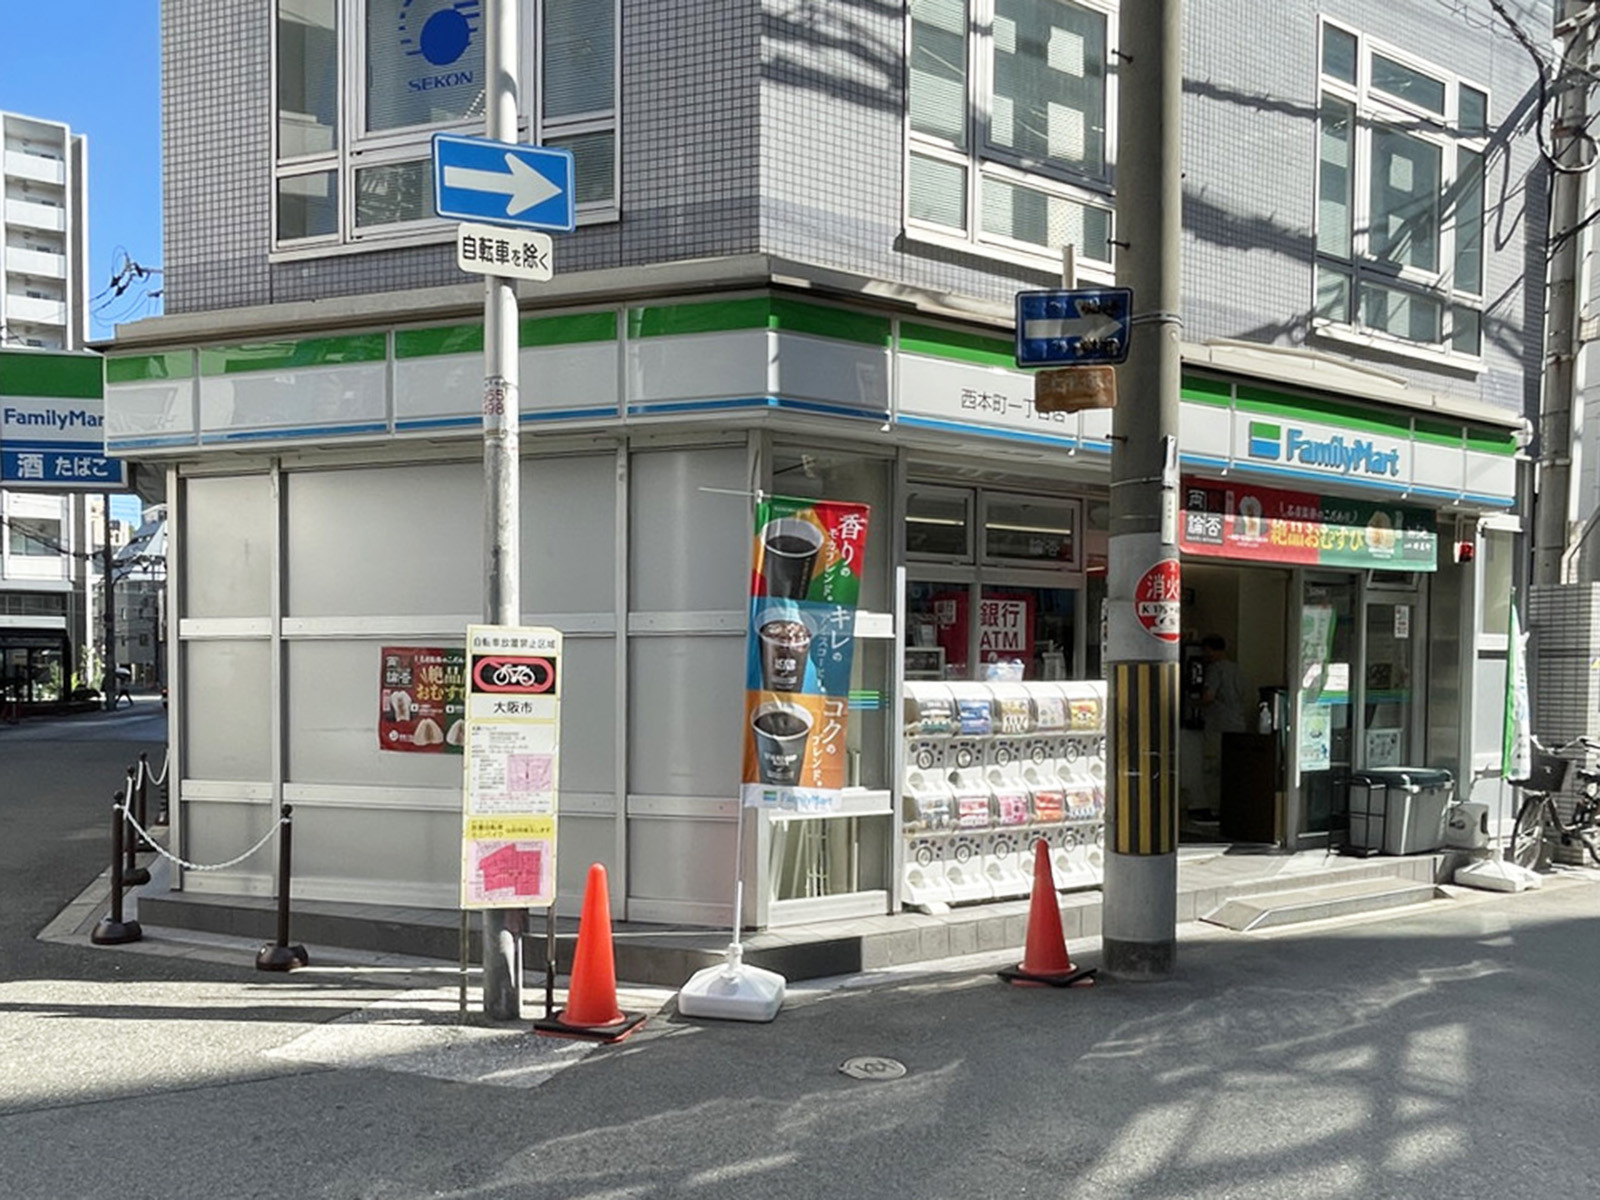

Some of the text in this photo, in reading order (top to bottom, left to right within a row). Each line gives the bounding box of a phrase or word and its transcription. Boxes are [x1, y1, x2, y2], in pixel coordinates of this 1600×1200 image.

[407, 71, 474, 93] SEKON
[462, 234, 549, 271] 自転車を除く
[17, 453, 109, 479] 酒 たばこ
[1286, 428, 1400, 477] FamilyMart
[837, 514, 868, 577] 香りの
[1271, 518, 1364, 552] 絶品おむすび
[979, 602, 1020, 628] 銀行
[473, 636, 556, 649] 自転車放置禁止区域
[830, 604, 852, 663] キレの
[979, 630, 1020, 649] ATM
[493, 701, 533, 715] 大阪市
[822, 700, 845, 756] コクの
